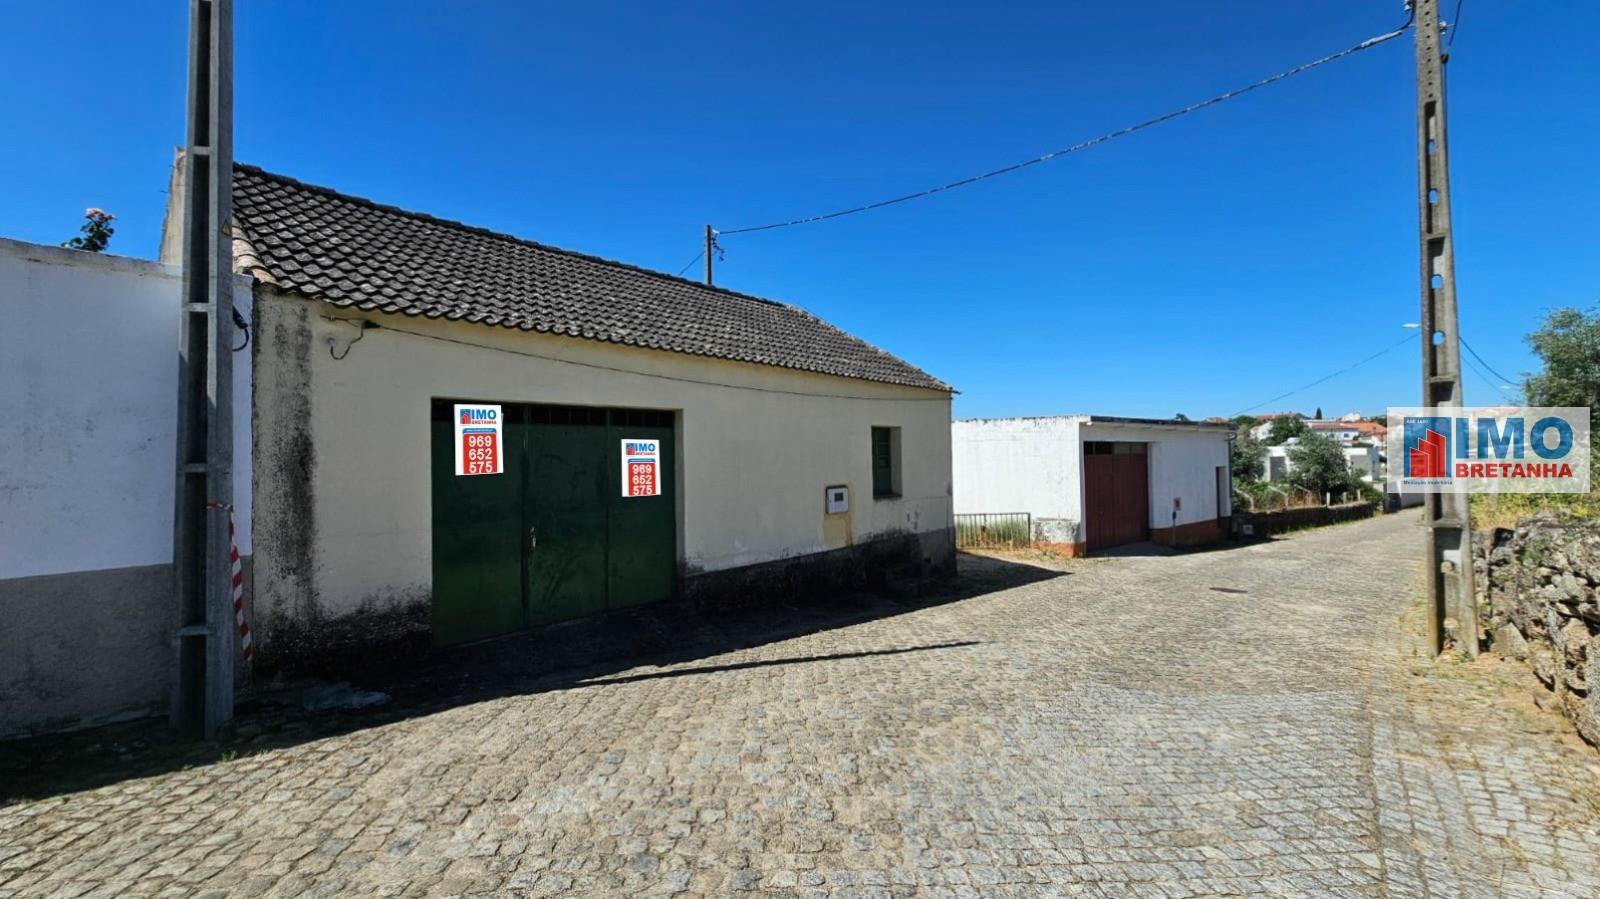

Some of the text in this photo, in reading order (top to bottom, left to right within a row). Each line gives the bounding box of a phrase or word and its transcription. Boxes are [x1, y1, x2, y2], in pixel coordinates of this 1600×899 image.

[471, 409, 497, 420] IMO
[469, 435, 492, 447] 969
[635, 443, 656, 452] IMO
[469, 448, 492, 460] 652
[470, 461, 493, 473] 575
[632, 464, 652, 474] 969
[633, 485, 653, 496] 575
